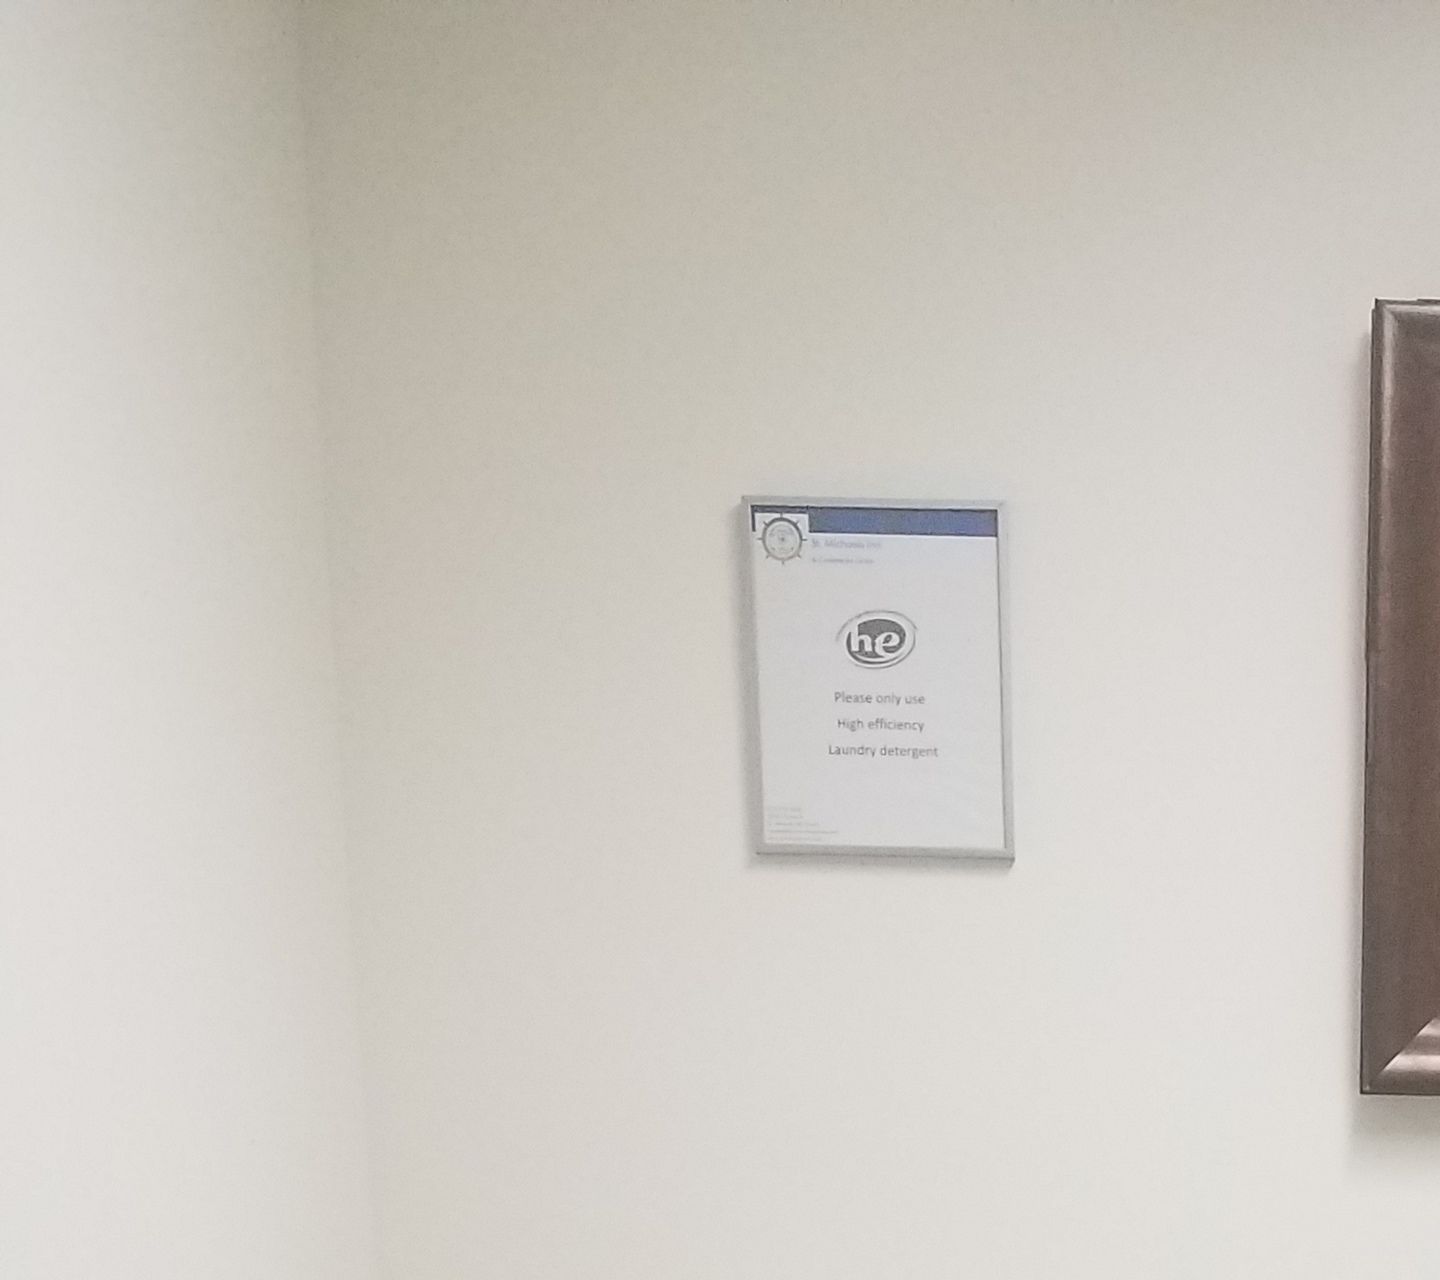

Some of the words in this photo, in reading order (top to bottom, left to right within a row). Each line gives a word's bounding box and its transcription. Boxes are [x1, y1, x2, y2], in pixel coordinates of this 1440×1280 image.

[847, 618, 906, 663] he
[833, 690, 873, 704] Please
[875, 691, 901, 706] only
[904, 694, 926, 705] use
[837, 718, 864, 732] High
[867, 717, 925, 733] efficiency
[828, 744, 876, 758] Laundry
[879, 745, 939, 760] detergent
